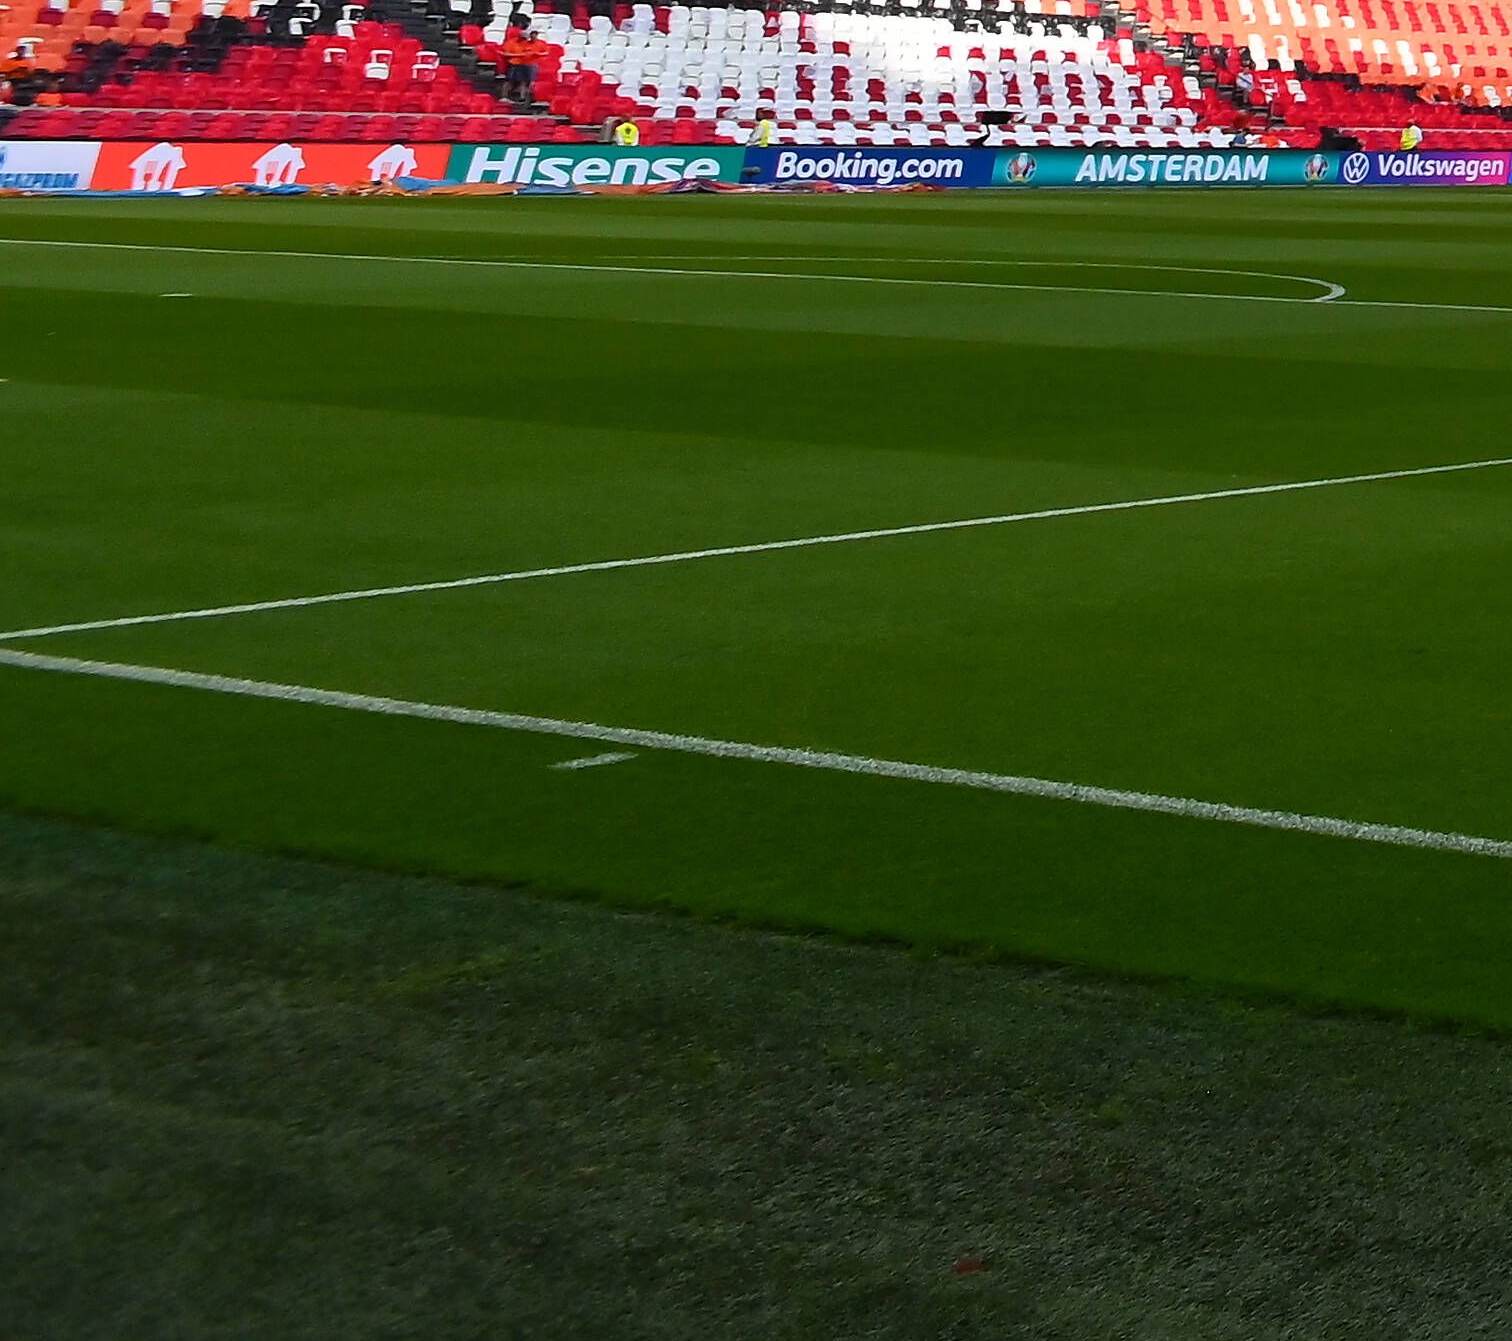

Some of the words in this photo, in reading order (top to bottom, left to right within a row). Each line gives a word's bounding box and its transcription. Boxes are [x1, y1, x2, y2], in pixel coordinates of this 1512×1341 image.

[465, 147, 721, 186] Hisense
[776, 151, 964, 184] Booking.com
[1074, 154, 1270, 182] AMSTERDAM
[1377, 153, 1505, 181] Volkswagen
